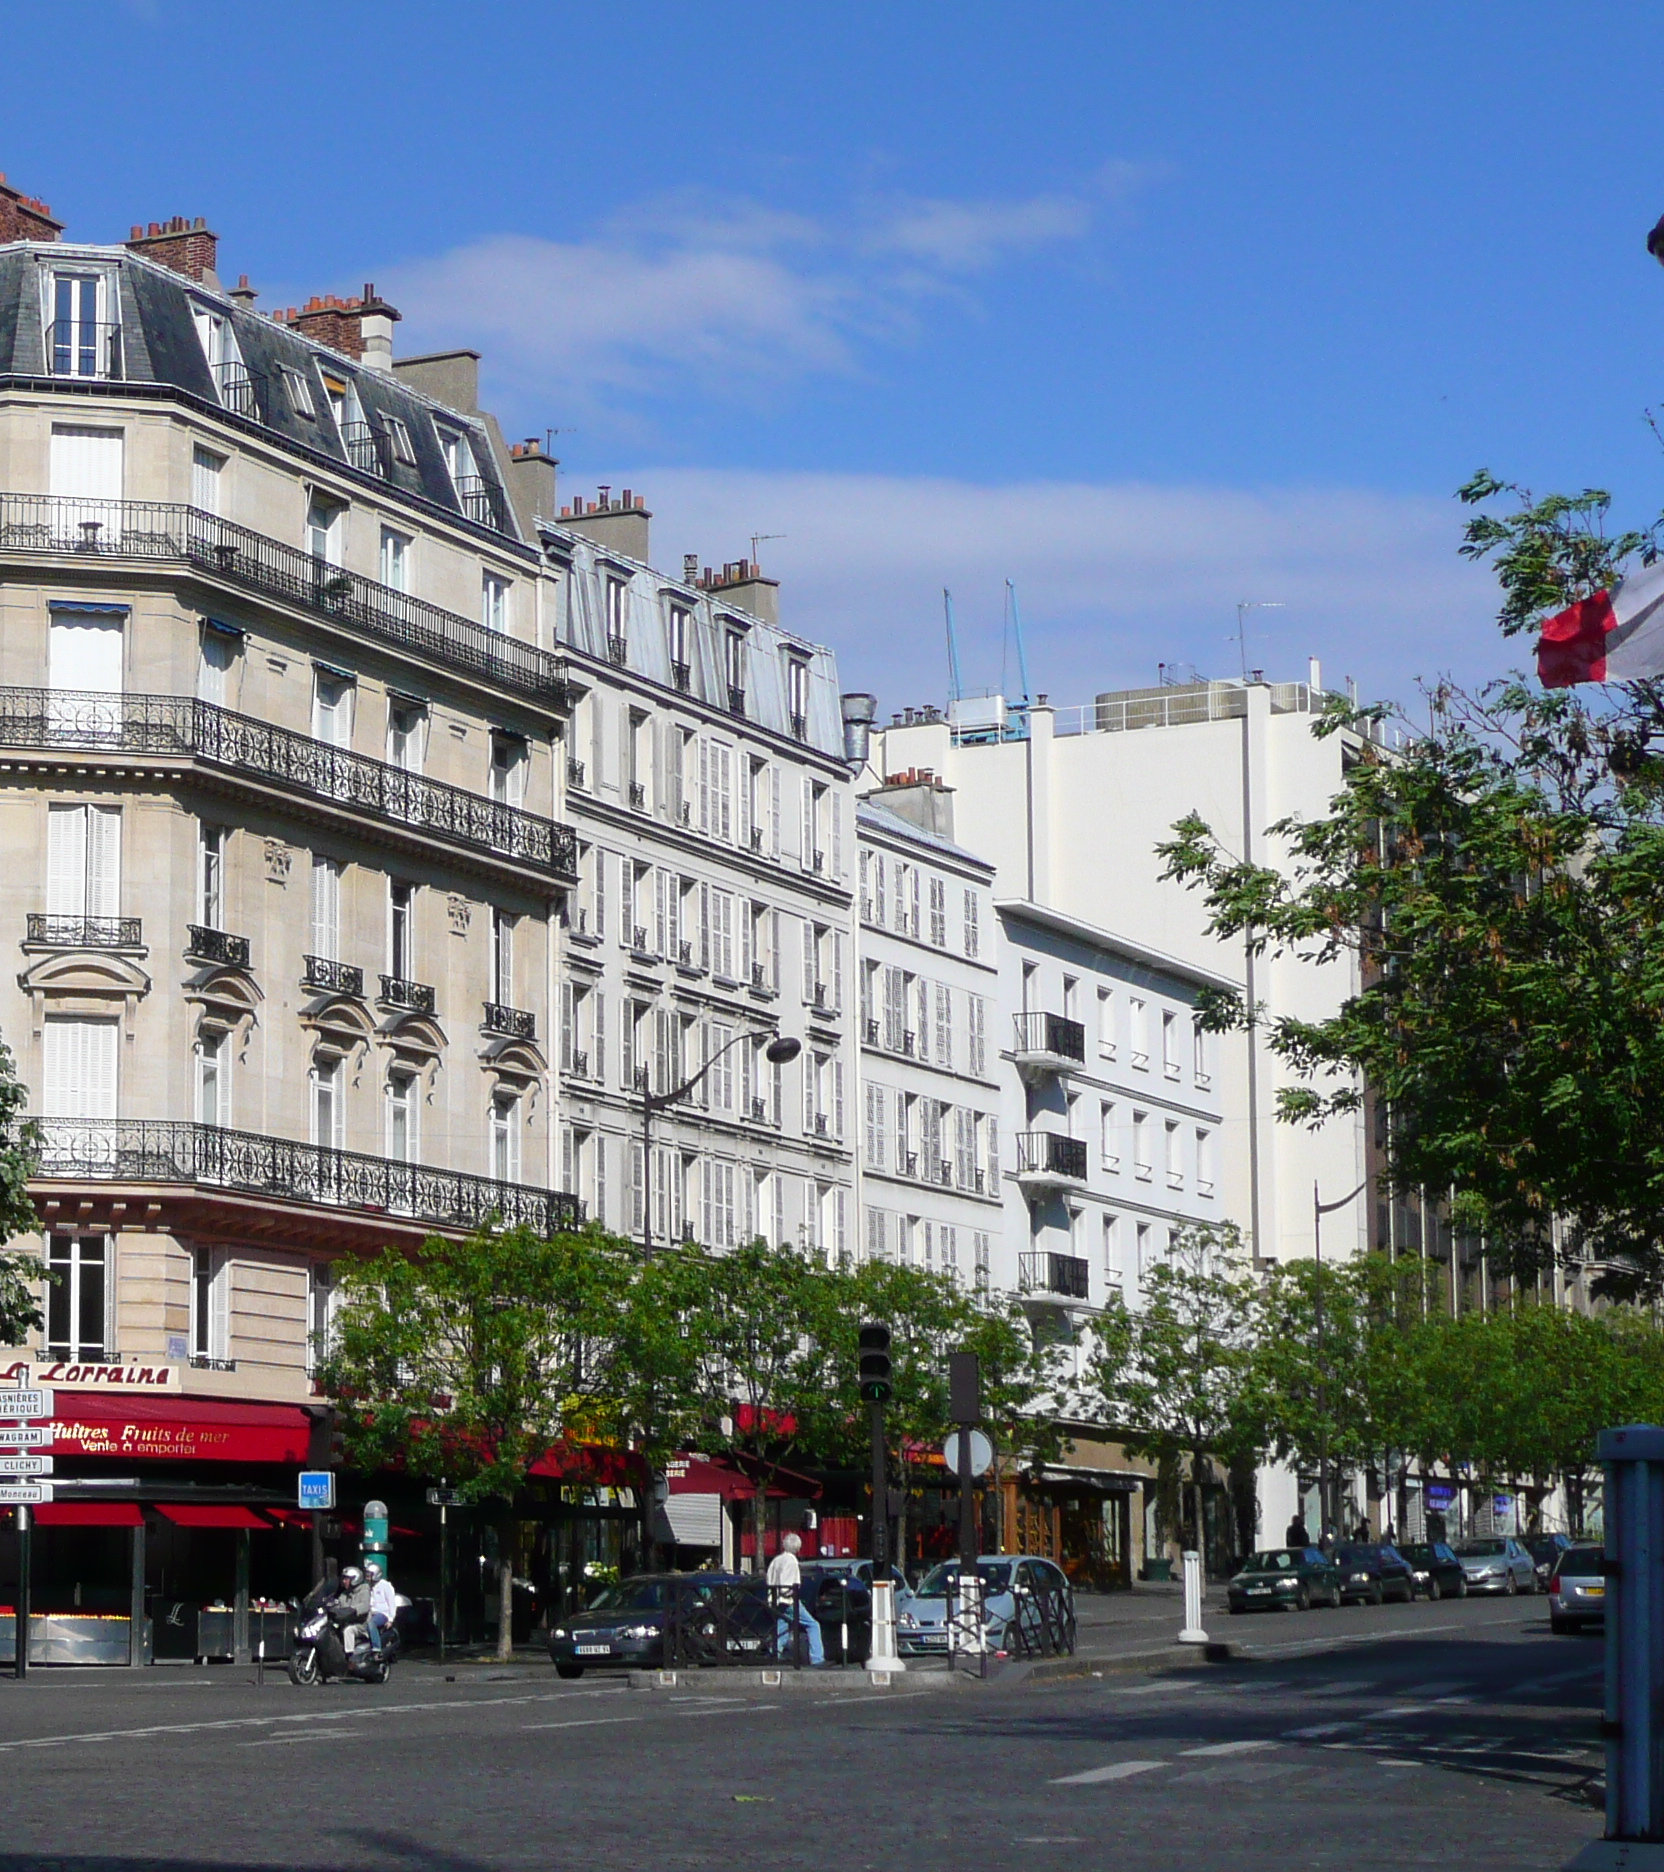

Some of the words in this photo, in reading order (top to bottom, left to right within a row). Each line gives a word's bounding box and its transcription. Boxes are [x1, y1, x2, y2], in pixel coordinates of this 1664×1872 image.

[37, 1357, 170, 1385] Lorraine
[48, 1422, 109, 1440] Huîtres
[121, 1424, 172, 1442] Fruits
[175, 1427, 195, 1442] de
[199, 1432, 231, 1444] mer
[80, 1439, 118, 1452] Vente
[137, 1442, 197, 1455] emporter
[4, 1461, 38, 1470] CLICHY
[0, 1489, 38, 1499] Monceau
[302, 1484, 328, 1495] TAXIS
